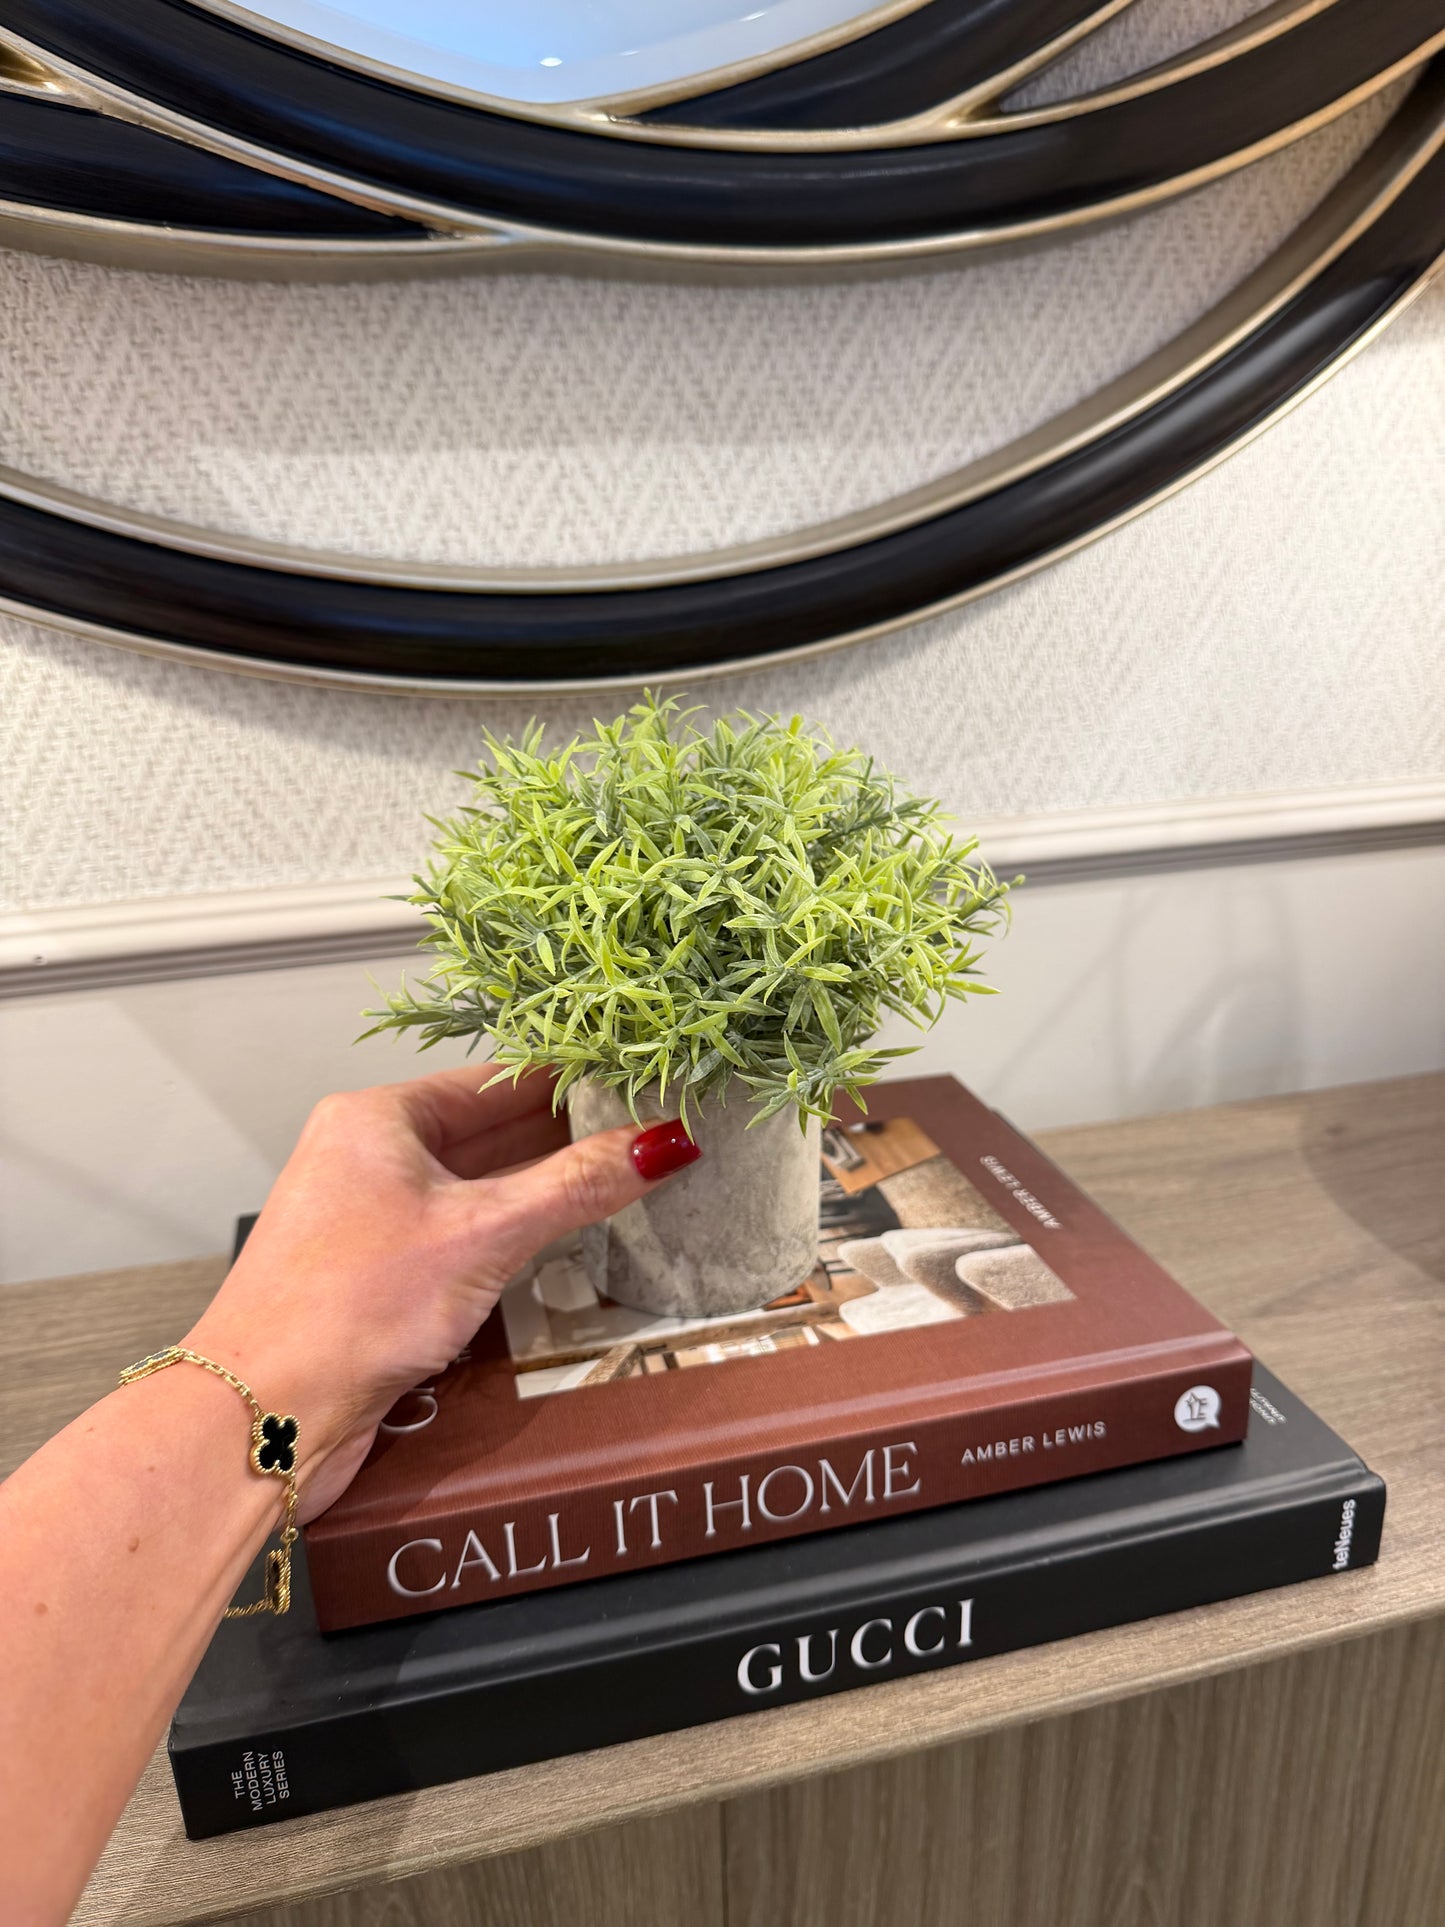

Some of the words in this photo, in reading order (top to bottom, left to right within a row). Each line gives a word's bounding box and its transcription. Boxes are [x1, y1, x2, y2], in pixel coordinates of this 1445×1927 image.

[980, 1155, 1021, 1190] LEWIS
[1012, 1188, 1063, 1230] AMBER
[961, 1435, 1035, 1465] AMBER
[1042, 1421, 1107, 1448] LEWIS
[387, 1512, 591, 1599] CALL
[613, 1490, 679, 1556] IT
[704, 1442, 922, 1538] HOME
[1331, 1499, 1357, 1570] teNeues
[736, 1598, 975, 1695] GUCCI
[231, 1770, 246, 1800] THE
[242, 1751, 264, 1812] MODERN
[257, 1752, 277, 1805] LUXURY
[272, 1750, 290, 1800] SERIES
